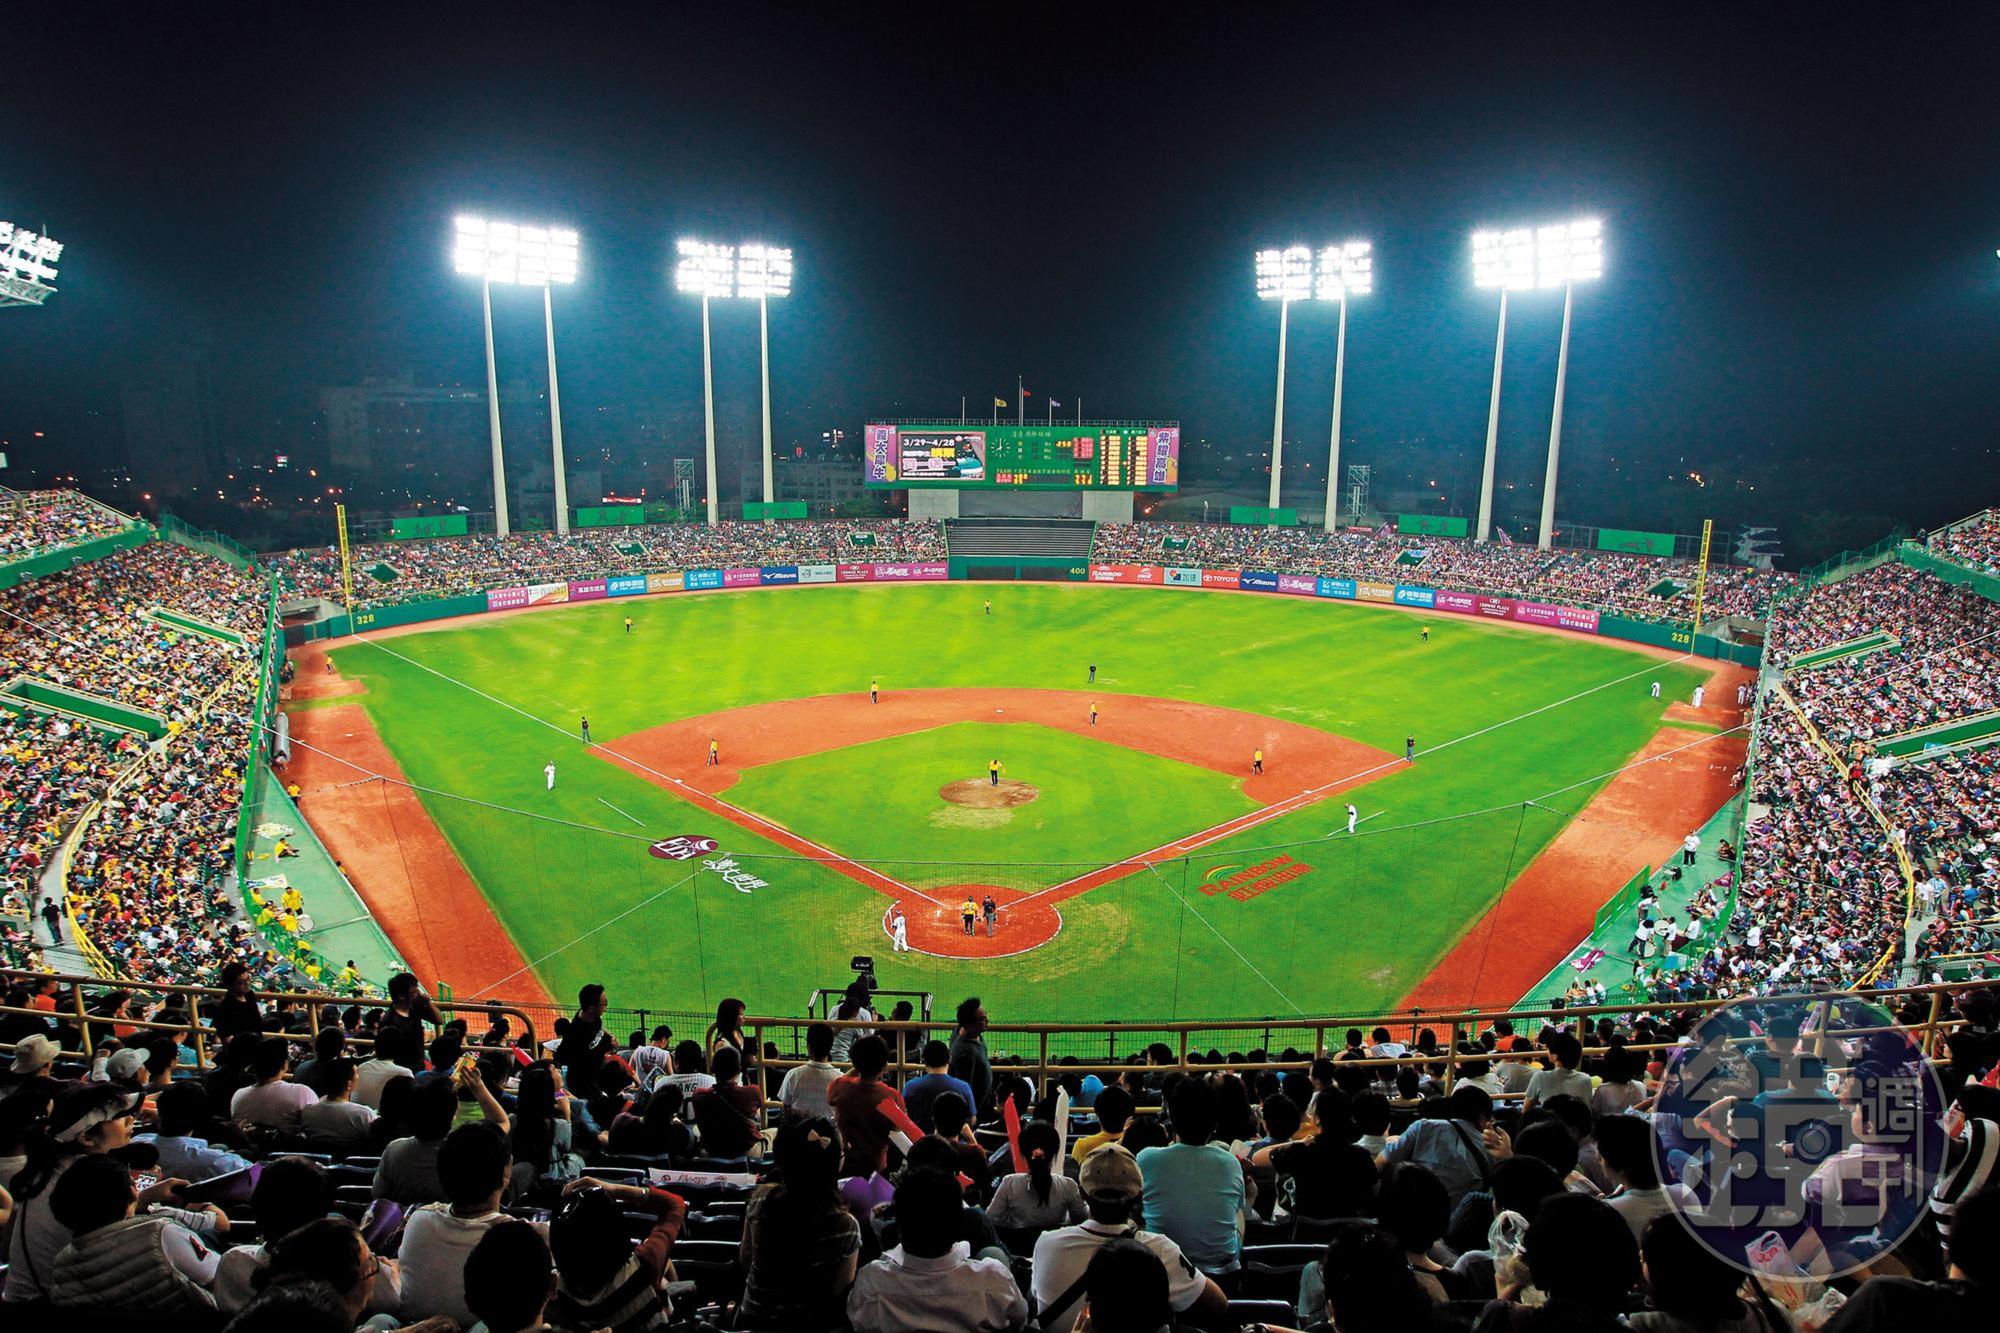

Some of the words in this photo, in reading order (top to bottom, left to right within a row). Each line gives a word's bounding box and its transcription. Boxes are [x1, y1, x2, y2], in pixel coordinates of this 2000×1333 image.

[1213, 575, 1239, 583] TOYOTA
[357, 614, 374, 624] 328
[1671, 632, 1690, 644] 328
[1199, 853, 1293, 896] RAINBOW
